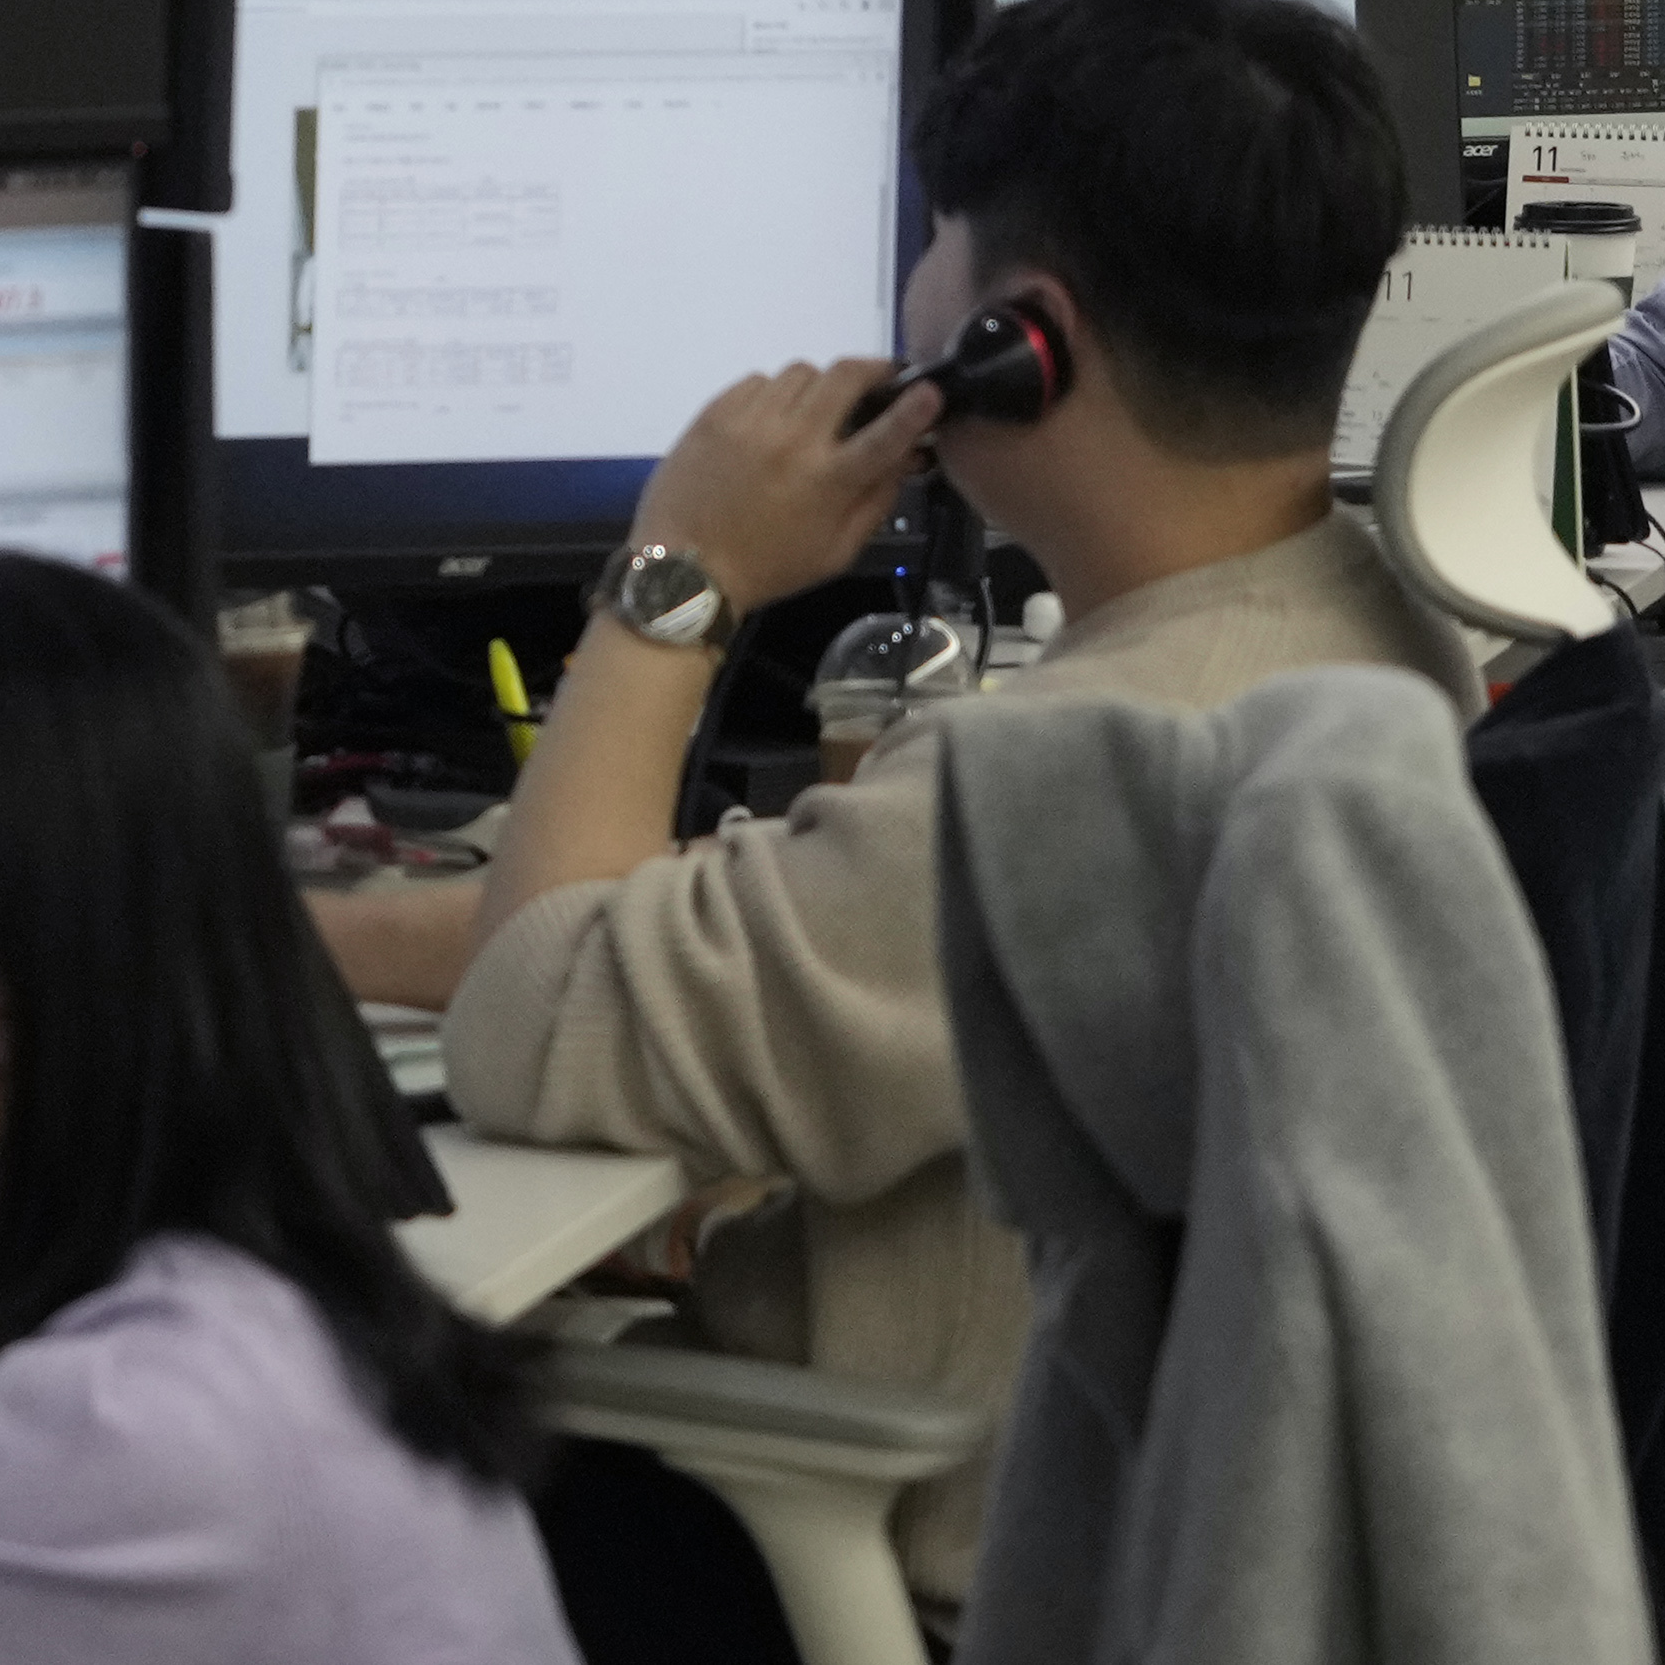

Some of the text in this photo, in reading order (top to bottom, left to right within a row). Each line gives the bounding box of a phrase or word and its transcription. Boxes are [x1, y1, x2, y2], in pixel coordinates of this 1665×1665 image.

[1463, 144, 1499, 158] acer
[1531, 145, 1559, 172] 11
[1383, 270, 1414, 303] 11
